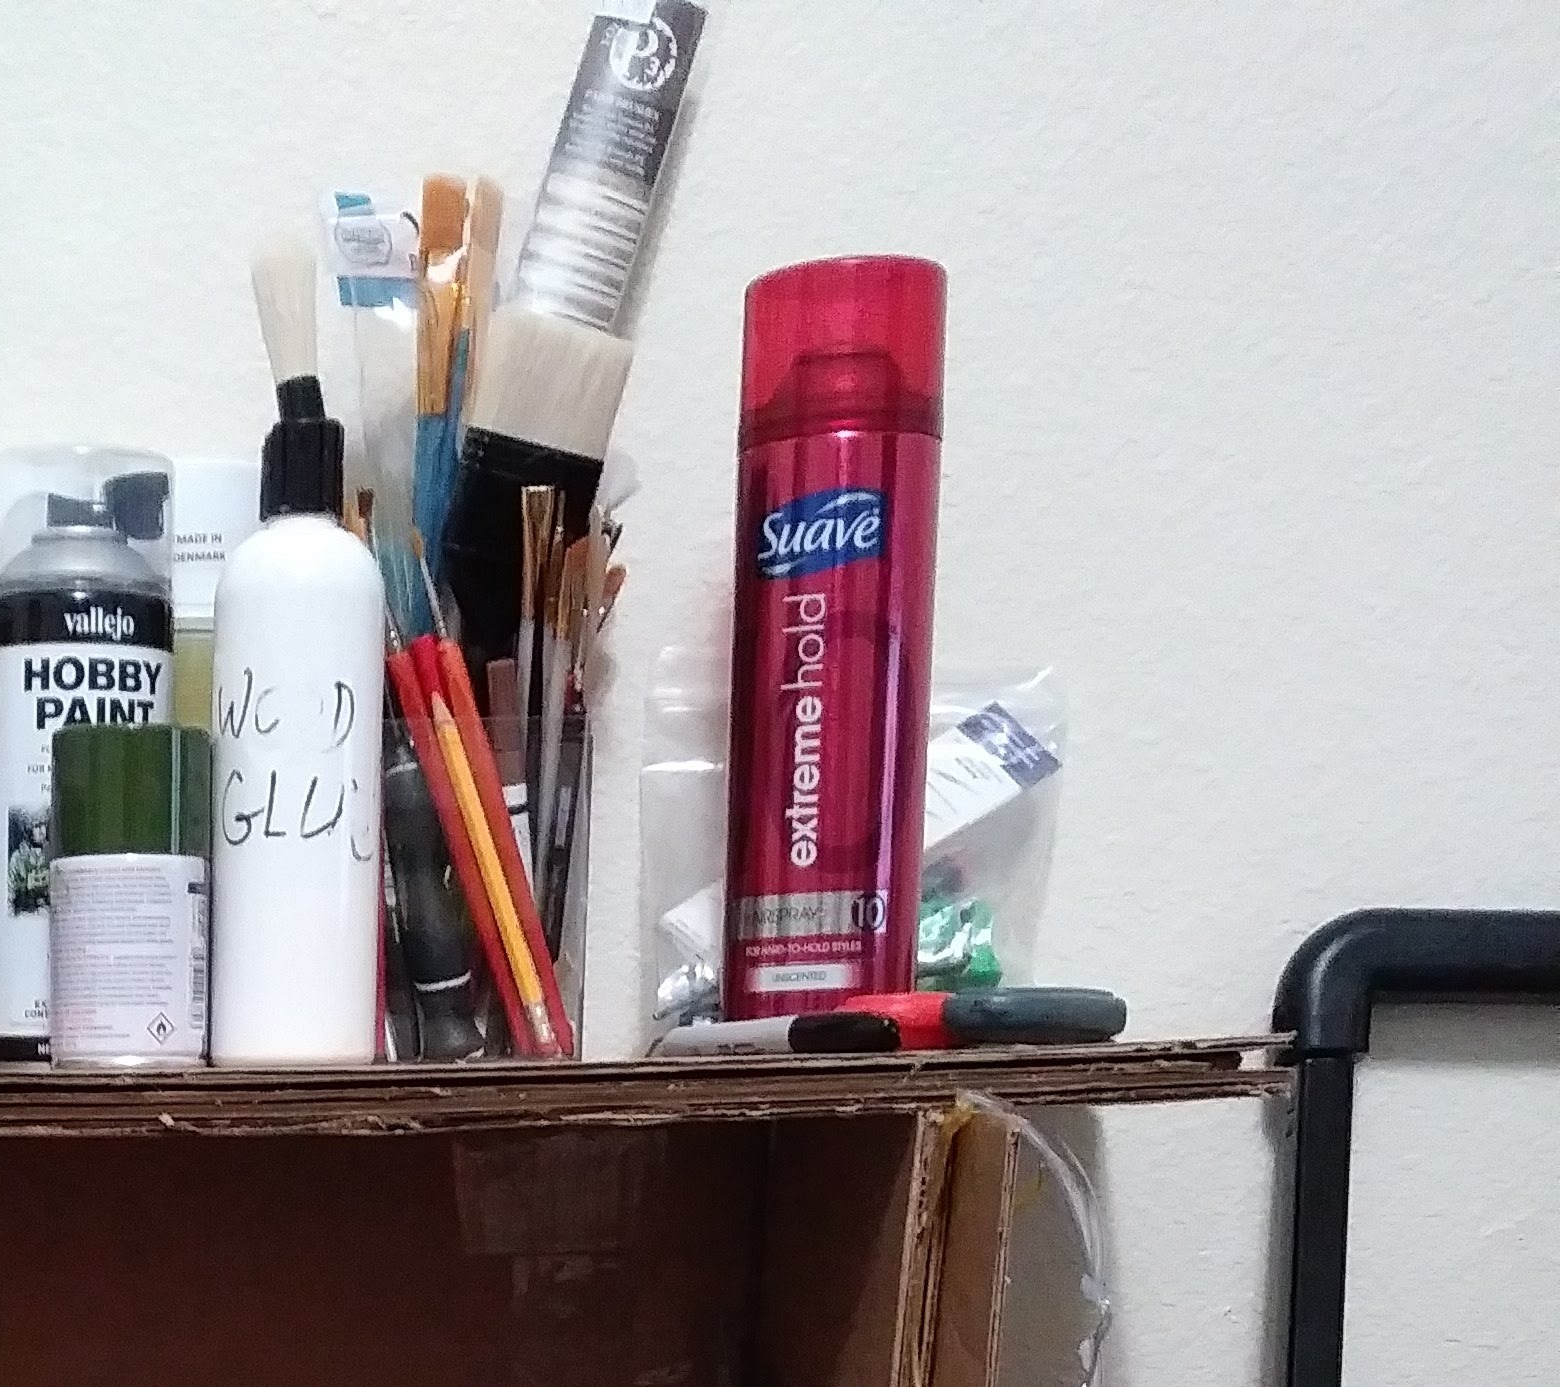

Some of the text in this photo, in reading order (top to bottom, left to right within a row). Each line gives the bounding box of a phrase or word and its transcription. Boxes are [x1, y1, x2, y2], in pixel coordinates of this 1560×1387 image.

[176, 533, 223, 544] MADE IN
[758, 508, 881, 561] Suave
[64, 606, 136, 640] vallejo
[23, 656, 163, 695] HOBBY
[35, 696, 155, 731] PAINT
